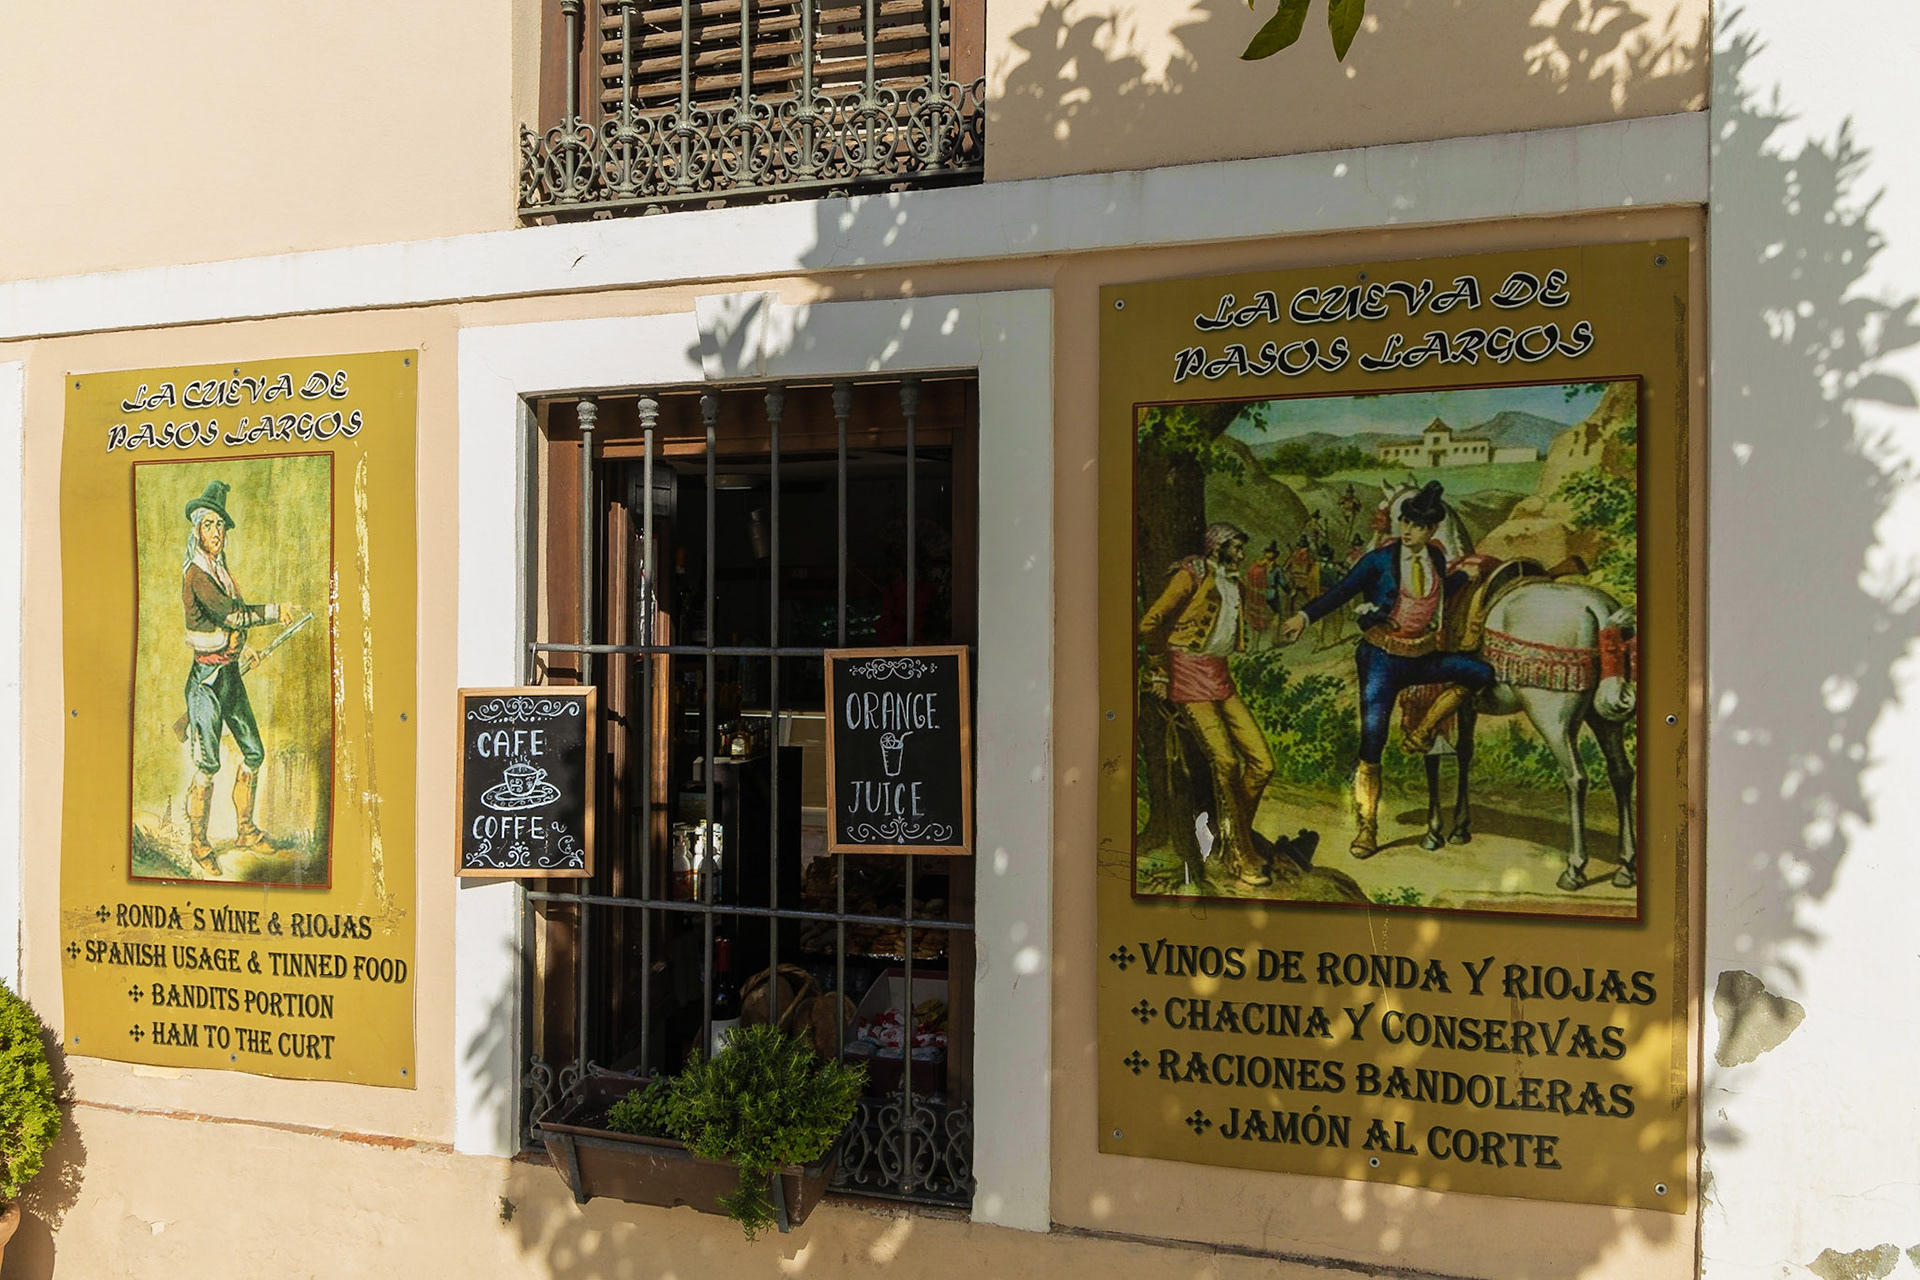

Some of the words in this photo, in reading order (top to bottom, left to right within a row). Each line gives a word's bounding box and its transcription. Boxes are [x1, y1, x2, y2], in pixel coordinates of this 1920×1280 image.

[1194, 288, 1280, 331] LA
[1288, 274, 1481, 324] CUEVA
[1491, 268, 1571, 310] DE
[1172, 337, 1351, 384] PASOS
[1359, 320, 1595, 372] LARGOS
[121, 382, 177, 412] LA
[182, 373, 294, 409] CUEVA
[299, 369, 350, 399] DE
[106, 419, 219, 452] PASOS
[223, 409, 363, 446] LARGOS
[477, 729, 544, 758] CAFE
[848, 781, 925, 817] JUICE
[473, 816, 546, 840] COFFE
[211, 904, 261, 935] WINE
[268, 912, 283, 936] &
[291, 912, 372, 940] RIOJAS
[85, 941, 167, 968] SPANISH
[172, 946, 241, 973] USAGE
[248, 951, 262, 974] &
[268, 952, 348, 979] TINNED
[353, 956, 408, 984] FOOD
[1138, 938, 1246, 981] VINOS
[1257, 948, 1305, 984] DE
[1316, 952, 1451, 995] RONDA
[1462, 956, 1496, 997] Y
[1502, 963, 1657, 1006] RIOJAS
[151, 983, 239, 1011] BANDITS
[244, 991, 334, 1019] PORTION
[151, 1022, 199, 1048] HAM
[203, 1025, 230, 1049] TO
[235, 1028, 272, 1055] THE
[278, 1032, 336, 1060] CURT
[1164, 996, 1332, 1039] CHACINA
[1343, 1002, 1375, 1041] Y
[1381, 1010, 1627, 1060] CONSERVAS
[1158, 1048, 1345, 1094] RACIONES
[1356, 1062, 1636, 1118] BANDOLERAS
[1219, 1105, 1352, 1150] JAMÓN
[1362, 1118, 1416, 1156] AL
[1426, 1125, 1562, 1170] CORTE
